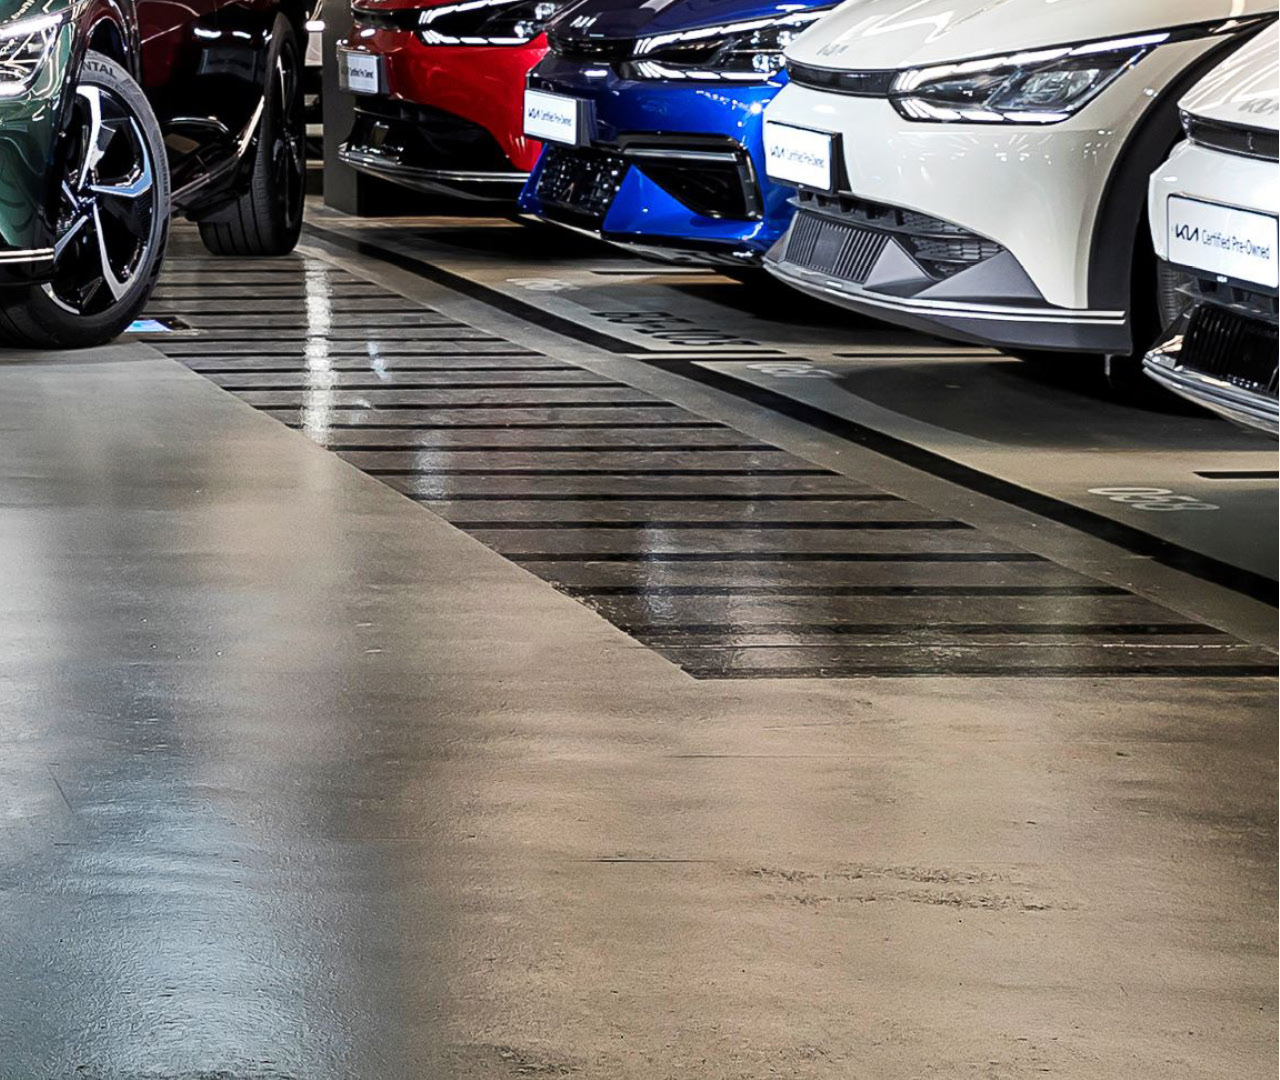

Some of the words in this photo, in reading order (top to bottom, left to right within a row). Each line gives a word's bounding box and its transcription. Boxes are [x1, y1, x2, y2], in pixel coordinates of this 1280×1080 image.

[1201, 229, 1231, 251] Certified
[1231, 236, 1271, 260] Pre-Owned
[1087, 486, 1221, 511] 058
